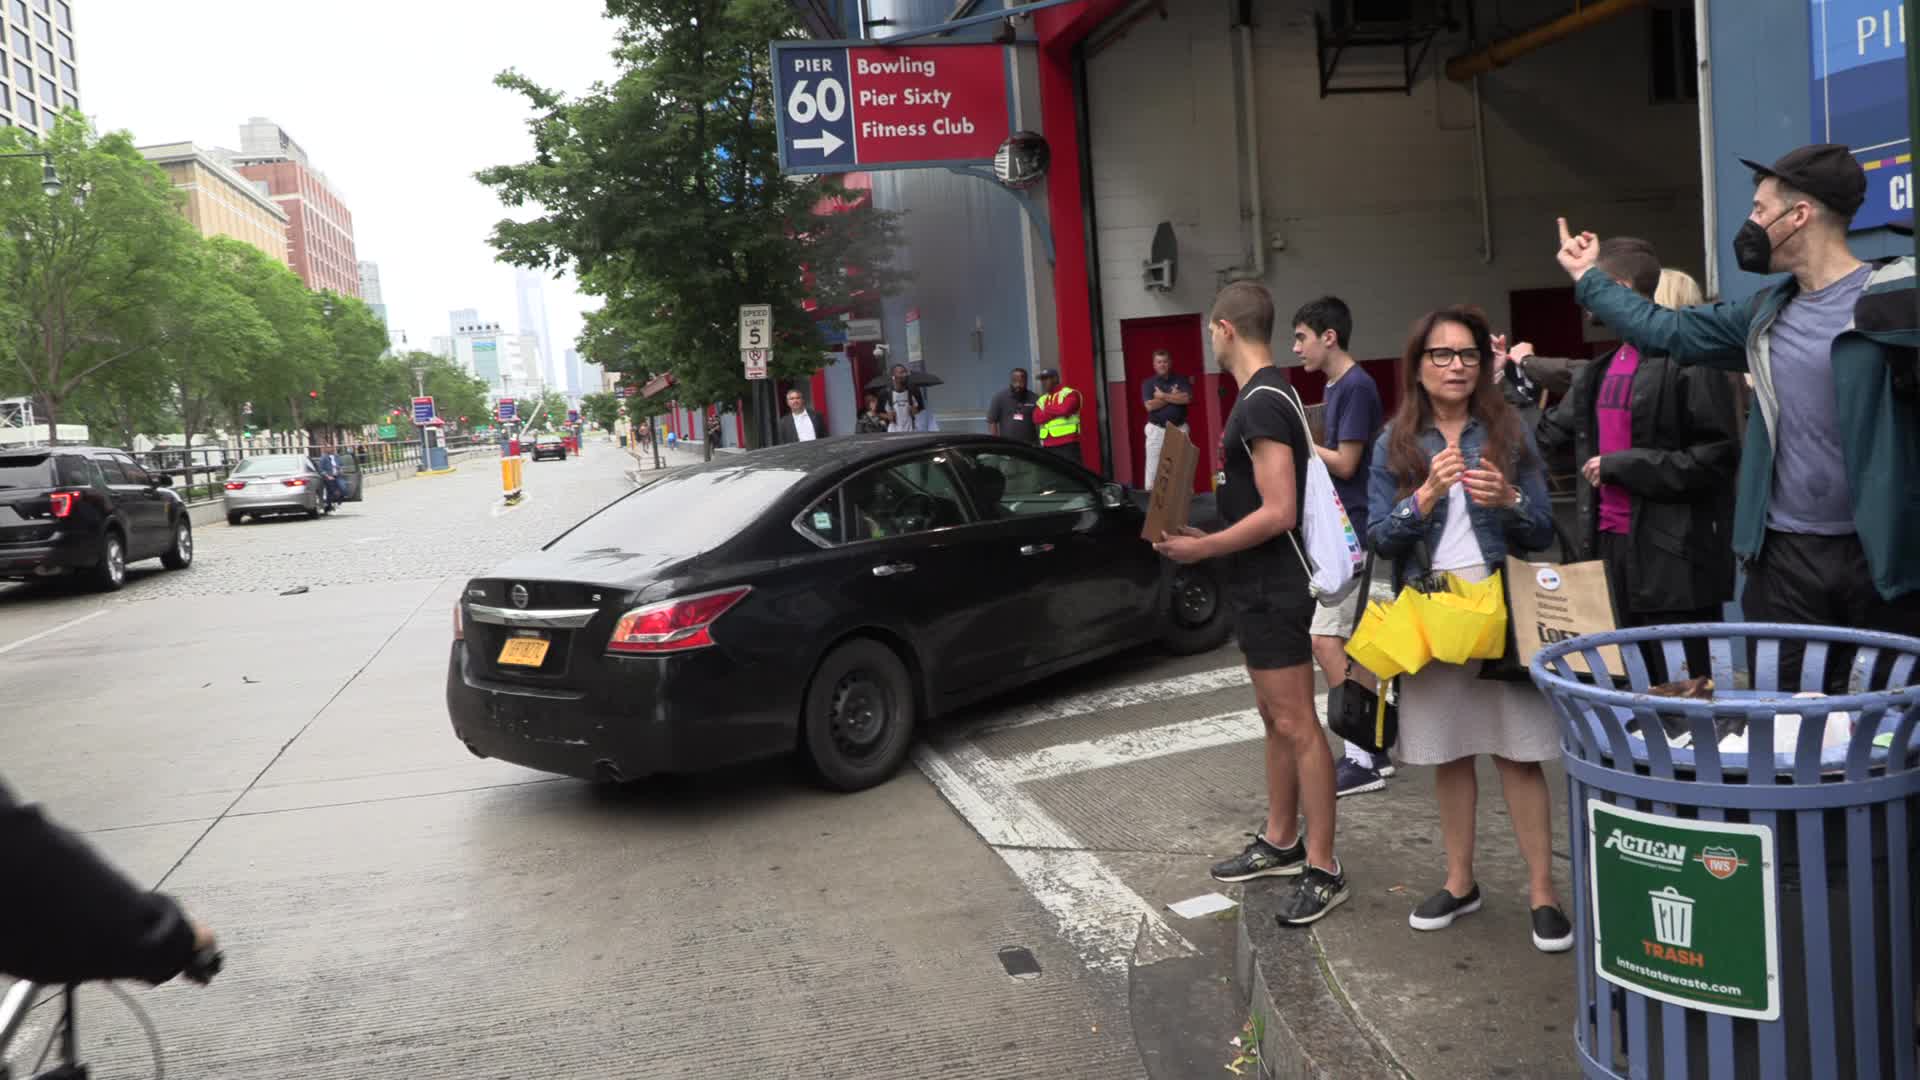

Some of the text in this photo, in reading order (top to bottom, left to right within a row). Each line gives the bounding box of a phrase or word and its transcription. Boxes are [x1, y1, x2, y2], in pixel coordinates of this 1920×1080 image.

[794, 58, 833, 73] PIER
[857, 56, 936, 77] Bowling
[788, 78, 846, 124] 60
[859, 88, 952, 108] Pier Sixty
[862, 117, 975, 138] Fitness Club
[743, 309, 768, 317] SPEED
[745, 319, 764, 327] LIMIT
[749, 329, 761, 345] 5
[1604, 828, 1687, 862] ACTION
[1710, 859, 1732, 872] IWS
[1642, 939, 1705, 968] TRASH
[1616, 956, 1742, 996] interstatewaste.com
